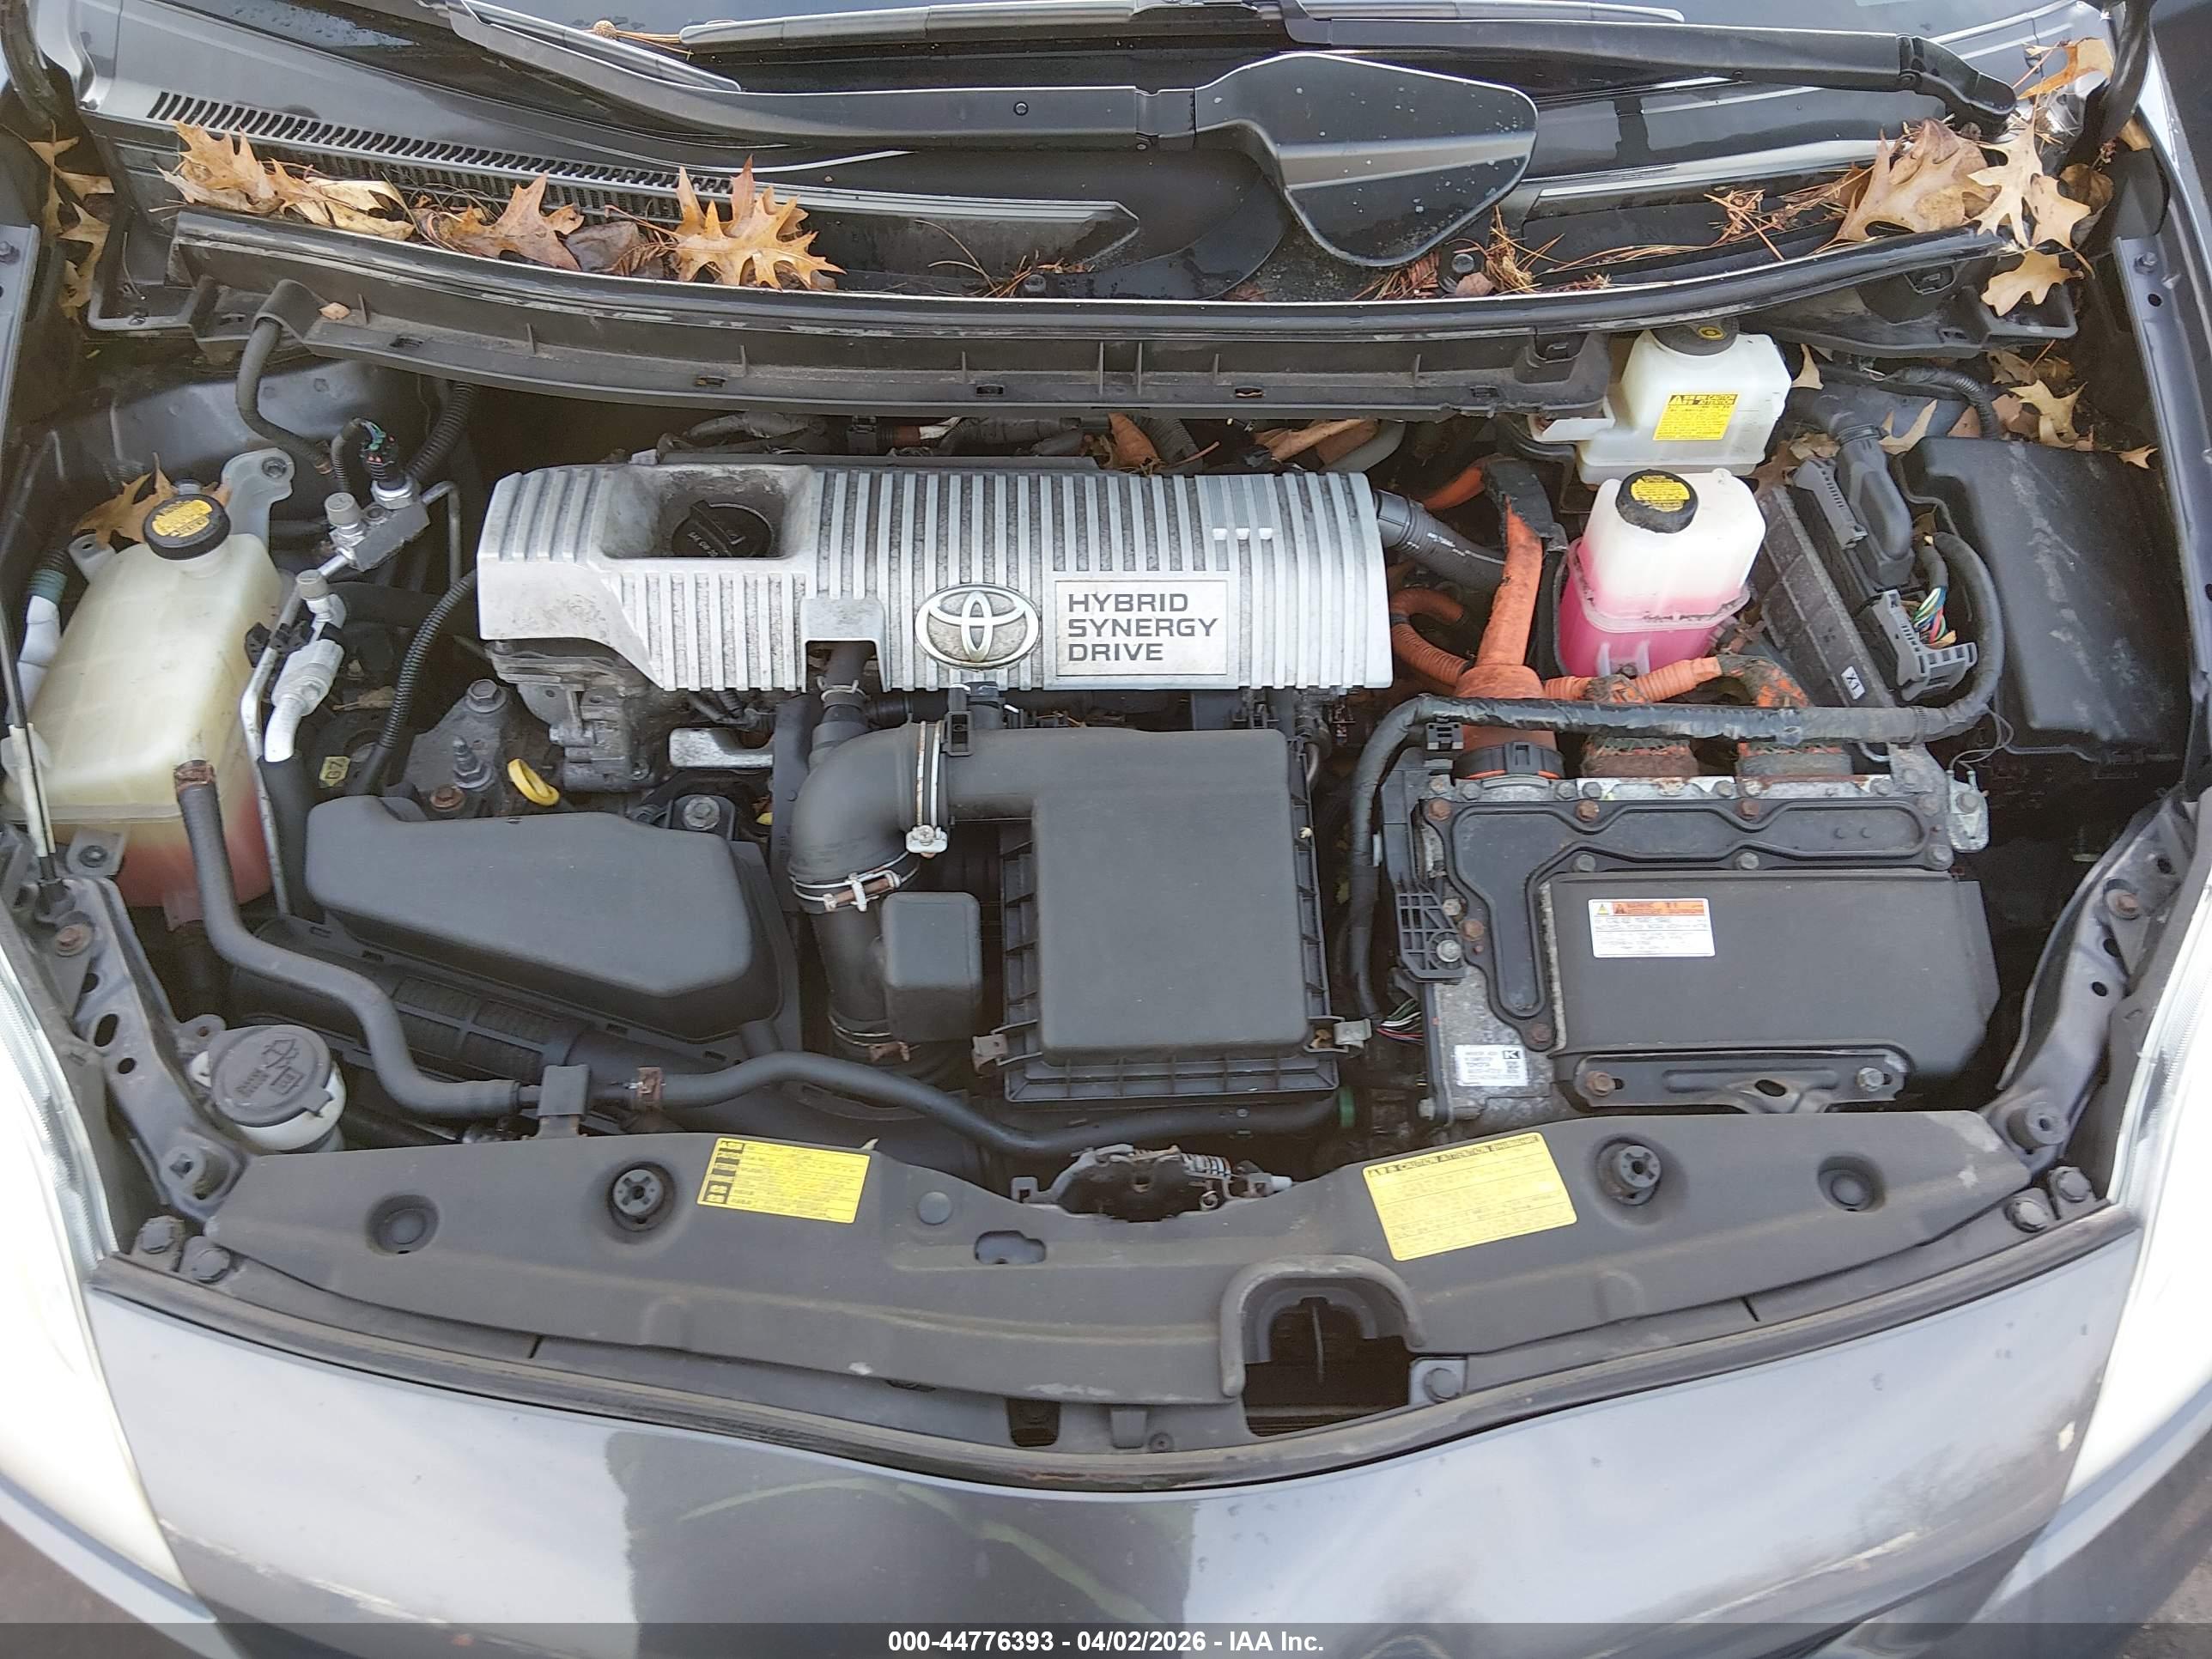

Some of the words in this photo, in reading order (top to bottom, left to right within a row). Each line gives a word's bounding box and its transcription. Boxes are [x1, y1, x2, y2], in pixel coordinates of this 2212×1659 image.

[1067, 593, 1189, 612] HYBRID
[1067, 617, 1219, 637] SYNERGY
[1067, 642, 1164, 661] DRIVE
